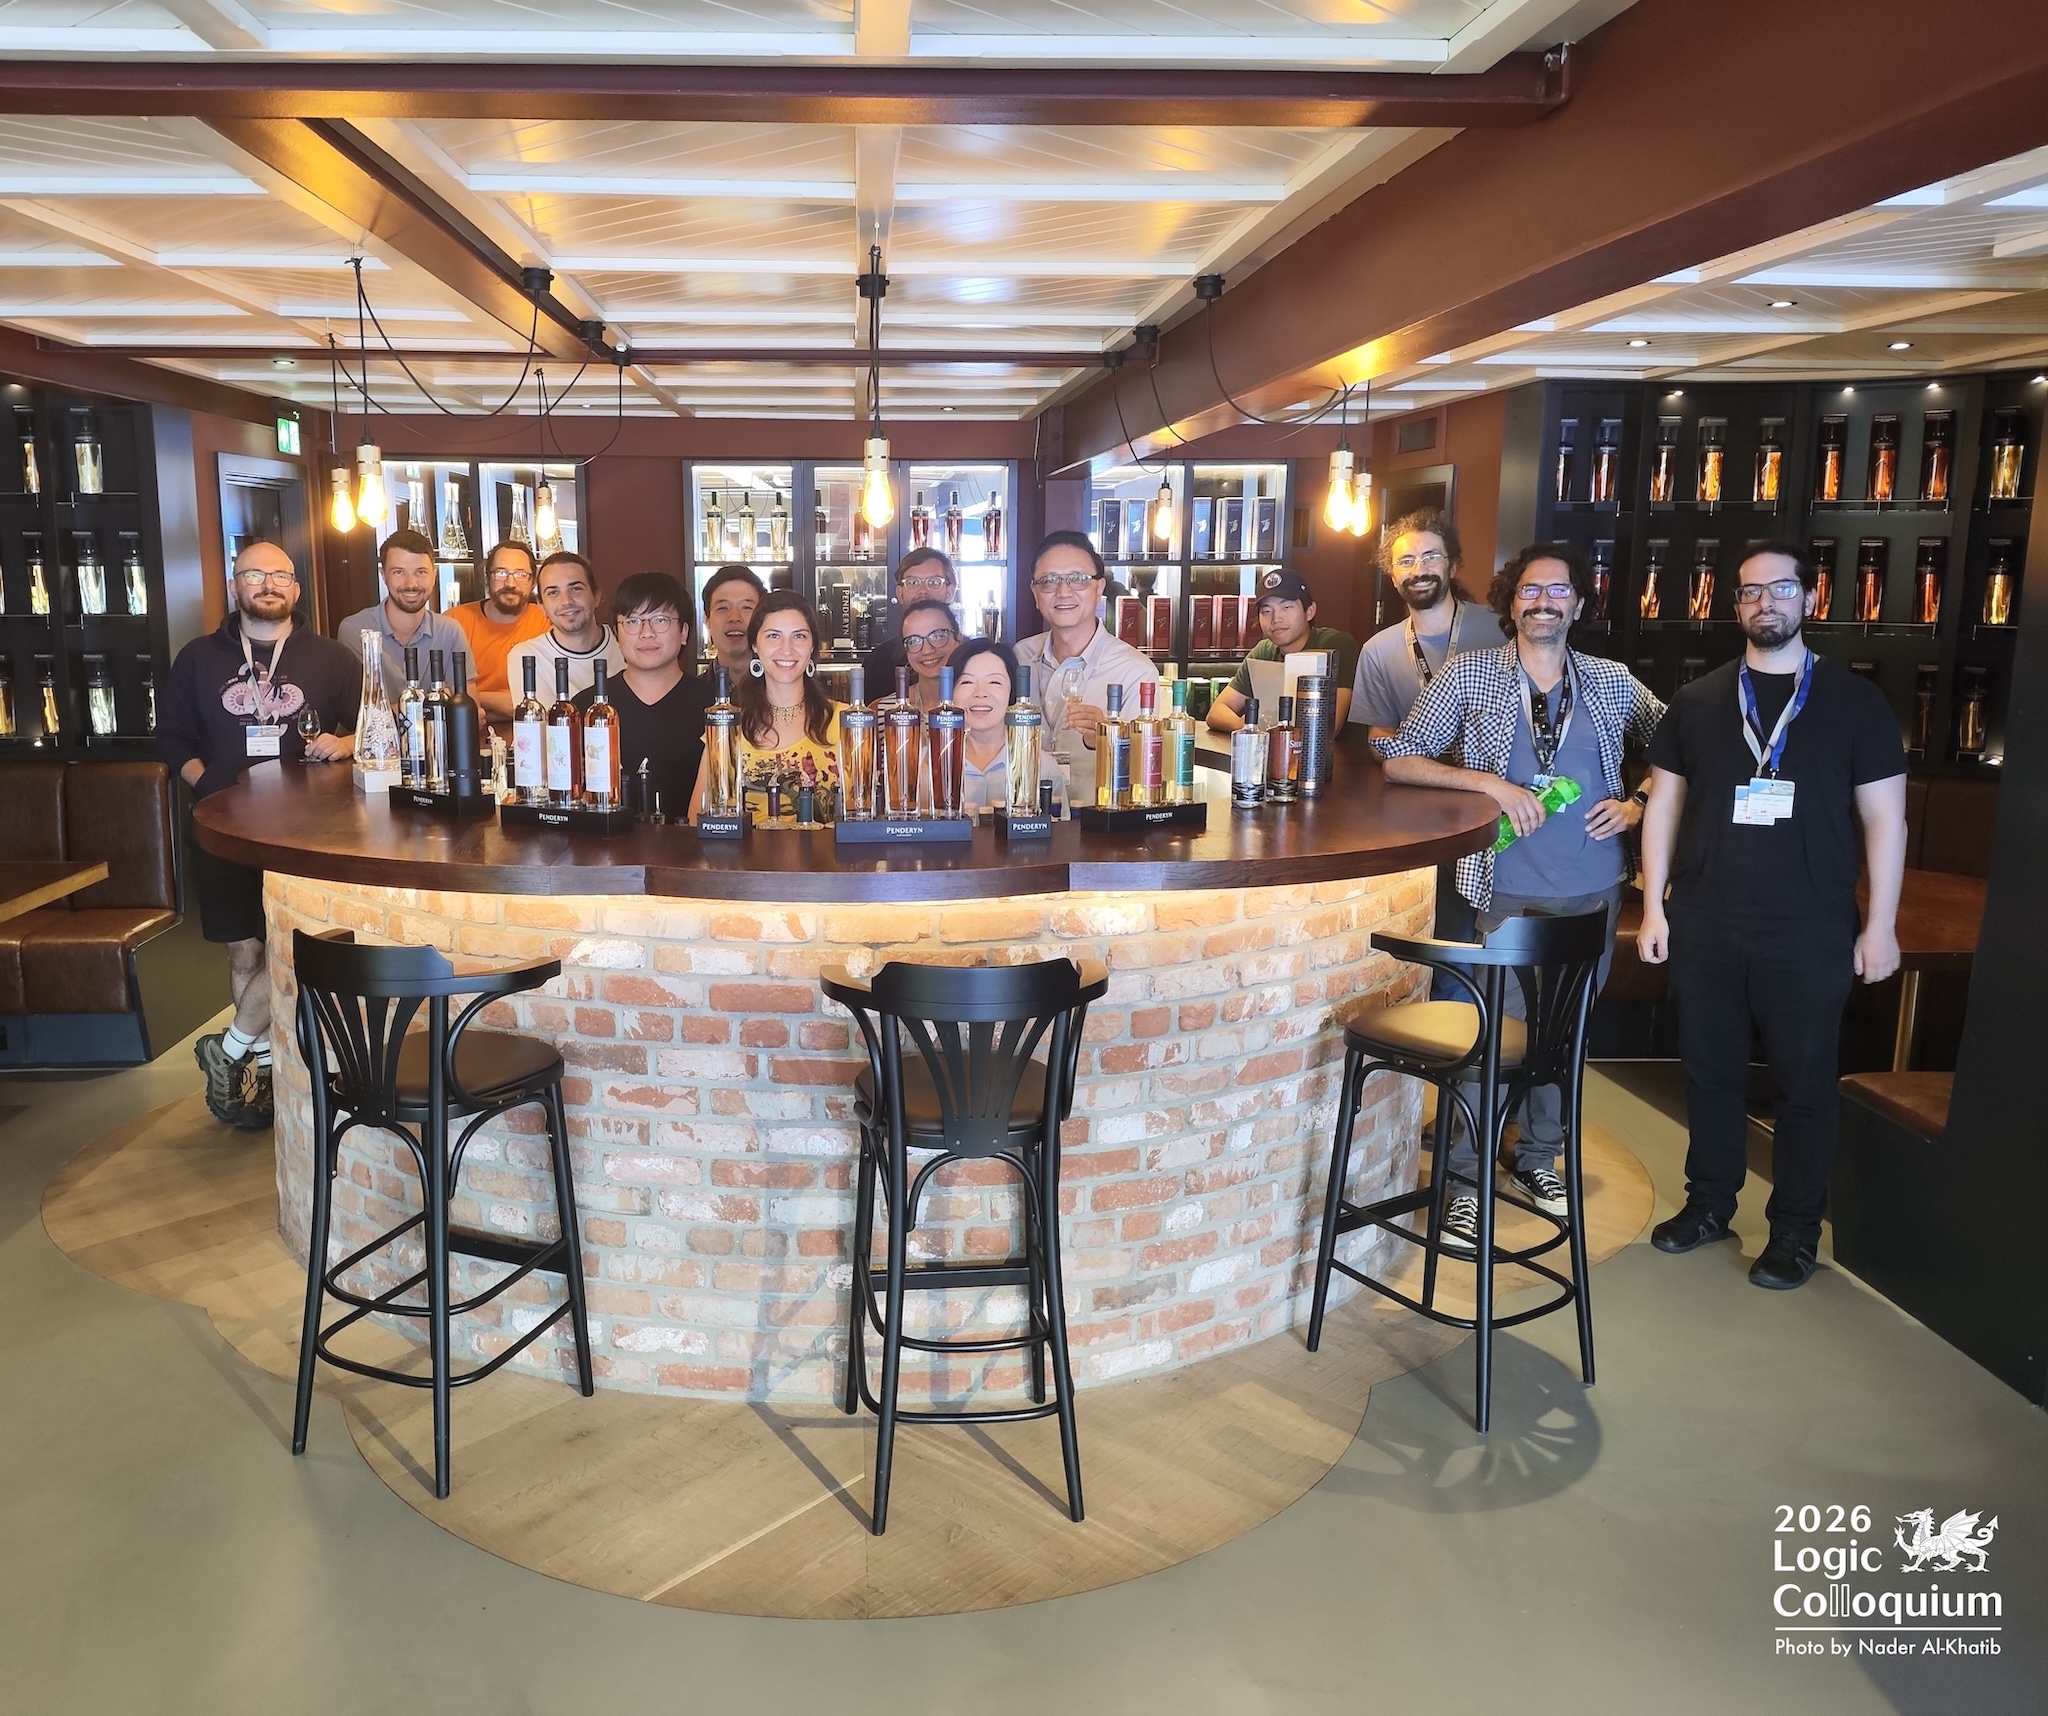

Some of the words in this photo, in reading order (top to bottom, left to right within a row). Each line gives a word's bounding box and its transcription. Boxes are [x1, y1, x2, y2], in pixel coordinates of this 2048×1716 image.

[538, 812, 569, 822] PENDERYN
[1145, 812, 1173, 821] PENDERYN
[702, 823, 738, 831] PENDERYN
[886, 826, 924, 834] PENDERYN
[1012, 823, 1048, 831] PENDERYN
